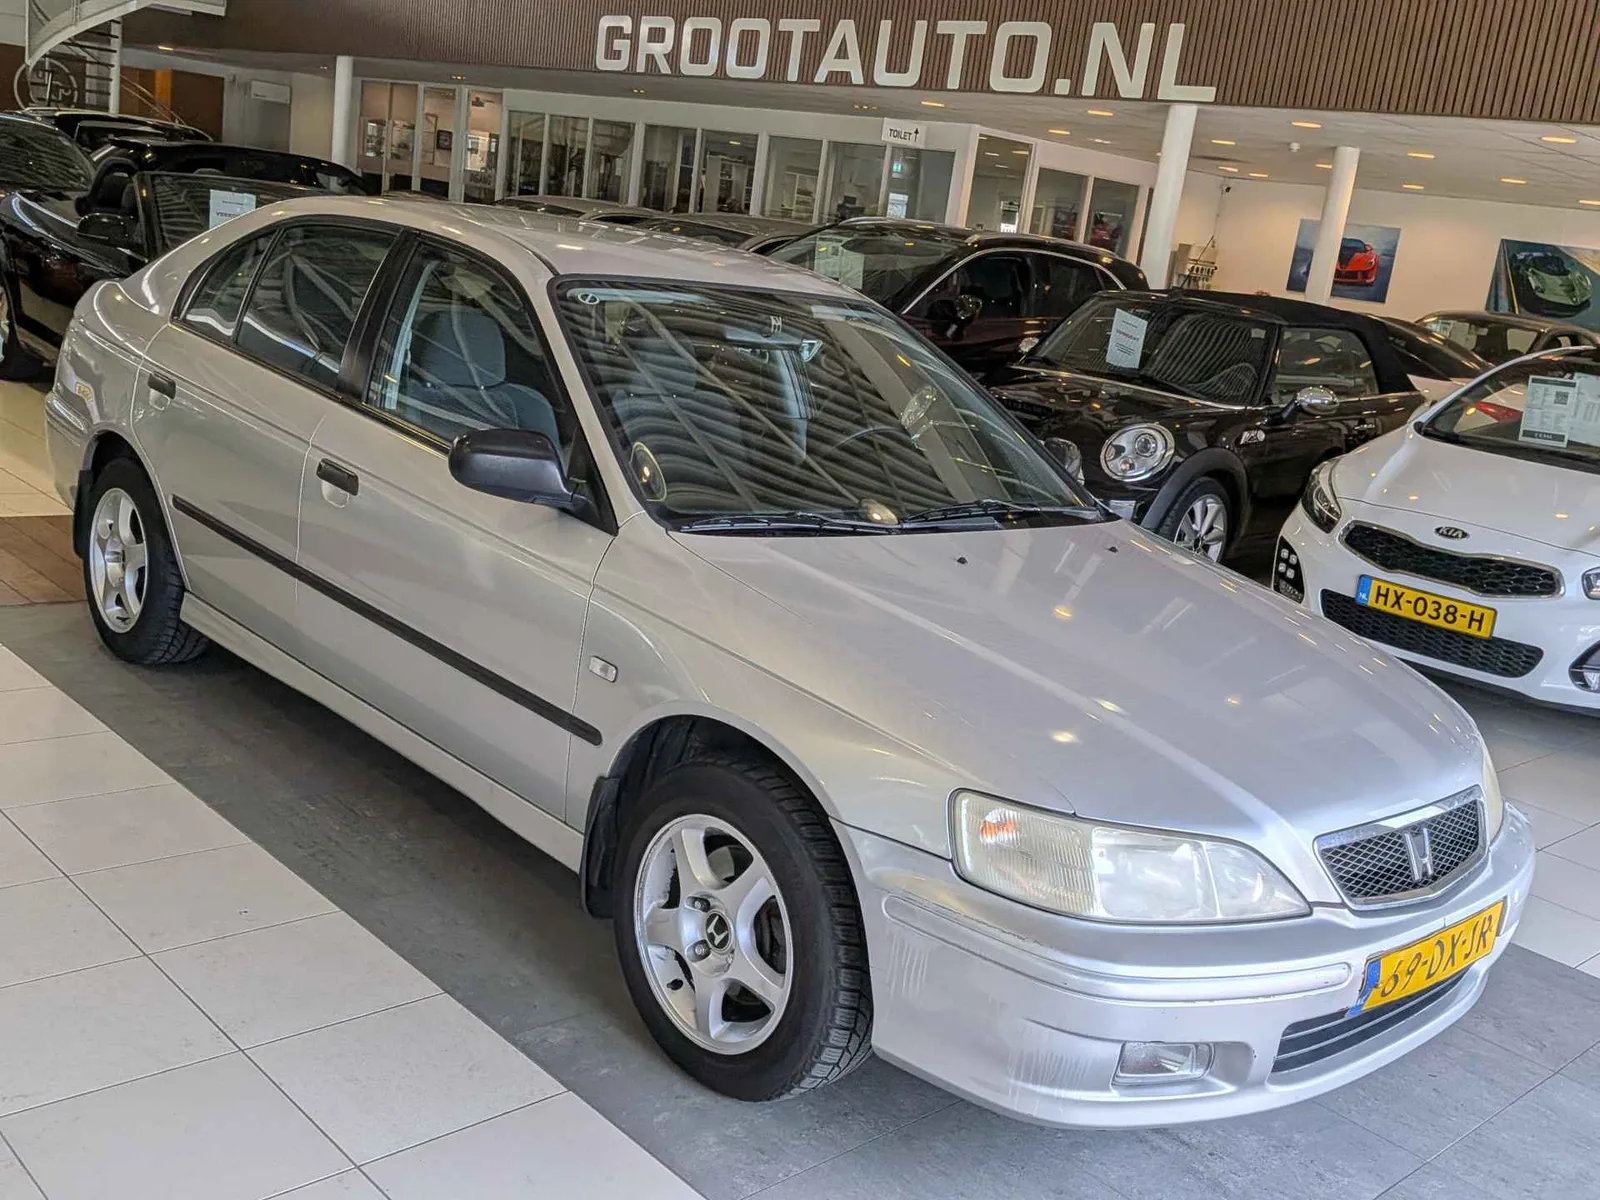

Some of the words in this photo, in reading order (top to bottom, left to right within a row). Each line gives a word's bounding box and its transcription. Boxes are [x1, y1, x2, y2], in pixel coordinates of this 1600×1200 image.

[596, 15, 1217, 102] GROOTAUTO.NL
[888, 128, 912, 141] TOILET
[1375, 585, 1485, 632] HX-038-H
[1380, 914, 1493, 997] 69-DX-JR
